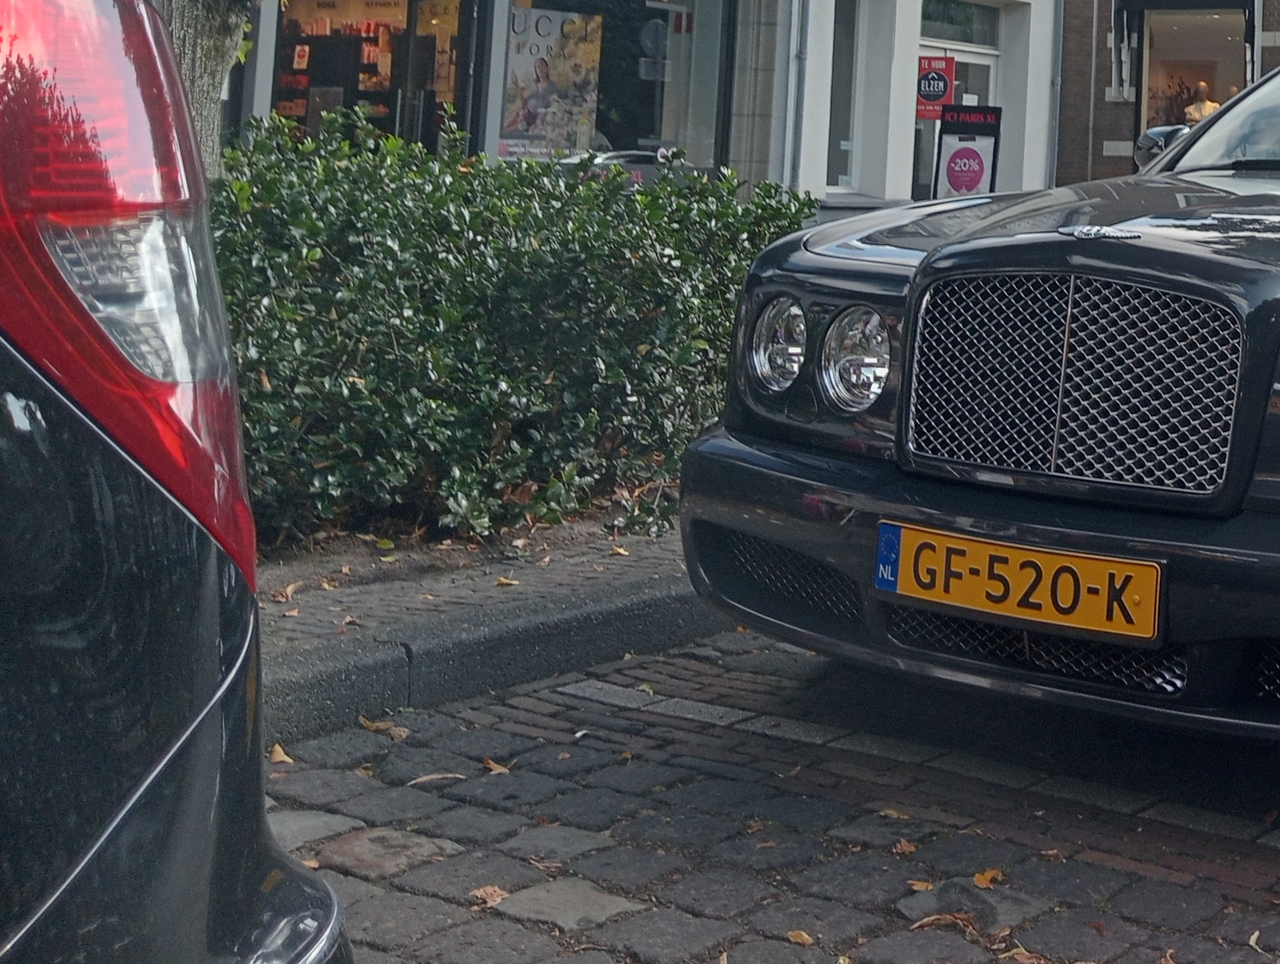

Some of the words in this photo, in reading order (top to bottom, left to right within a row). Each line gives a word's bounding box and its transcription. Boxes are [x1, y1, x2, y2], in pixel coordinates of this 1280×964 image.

[511, 12, 588, 41] UCCI
[921, 59, 929, 68] TE
[921, 80, 944, 91] ELZEN
[945, 112, 957, 122] ICI
[959, 112, 985, 123] PARIS
[986, 114, 996, 124] XL
[950, 158, 980, 172] -20%
[878, 564, 895, 582] NL
[912, 540, 1136, 626] GF-520-K
